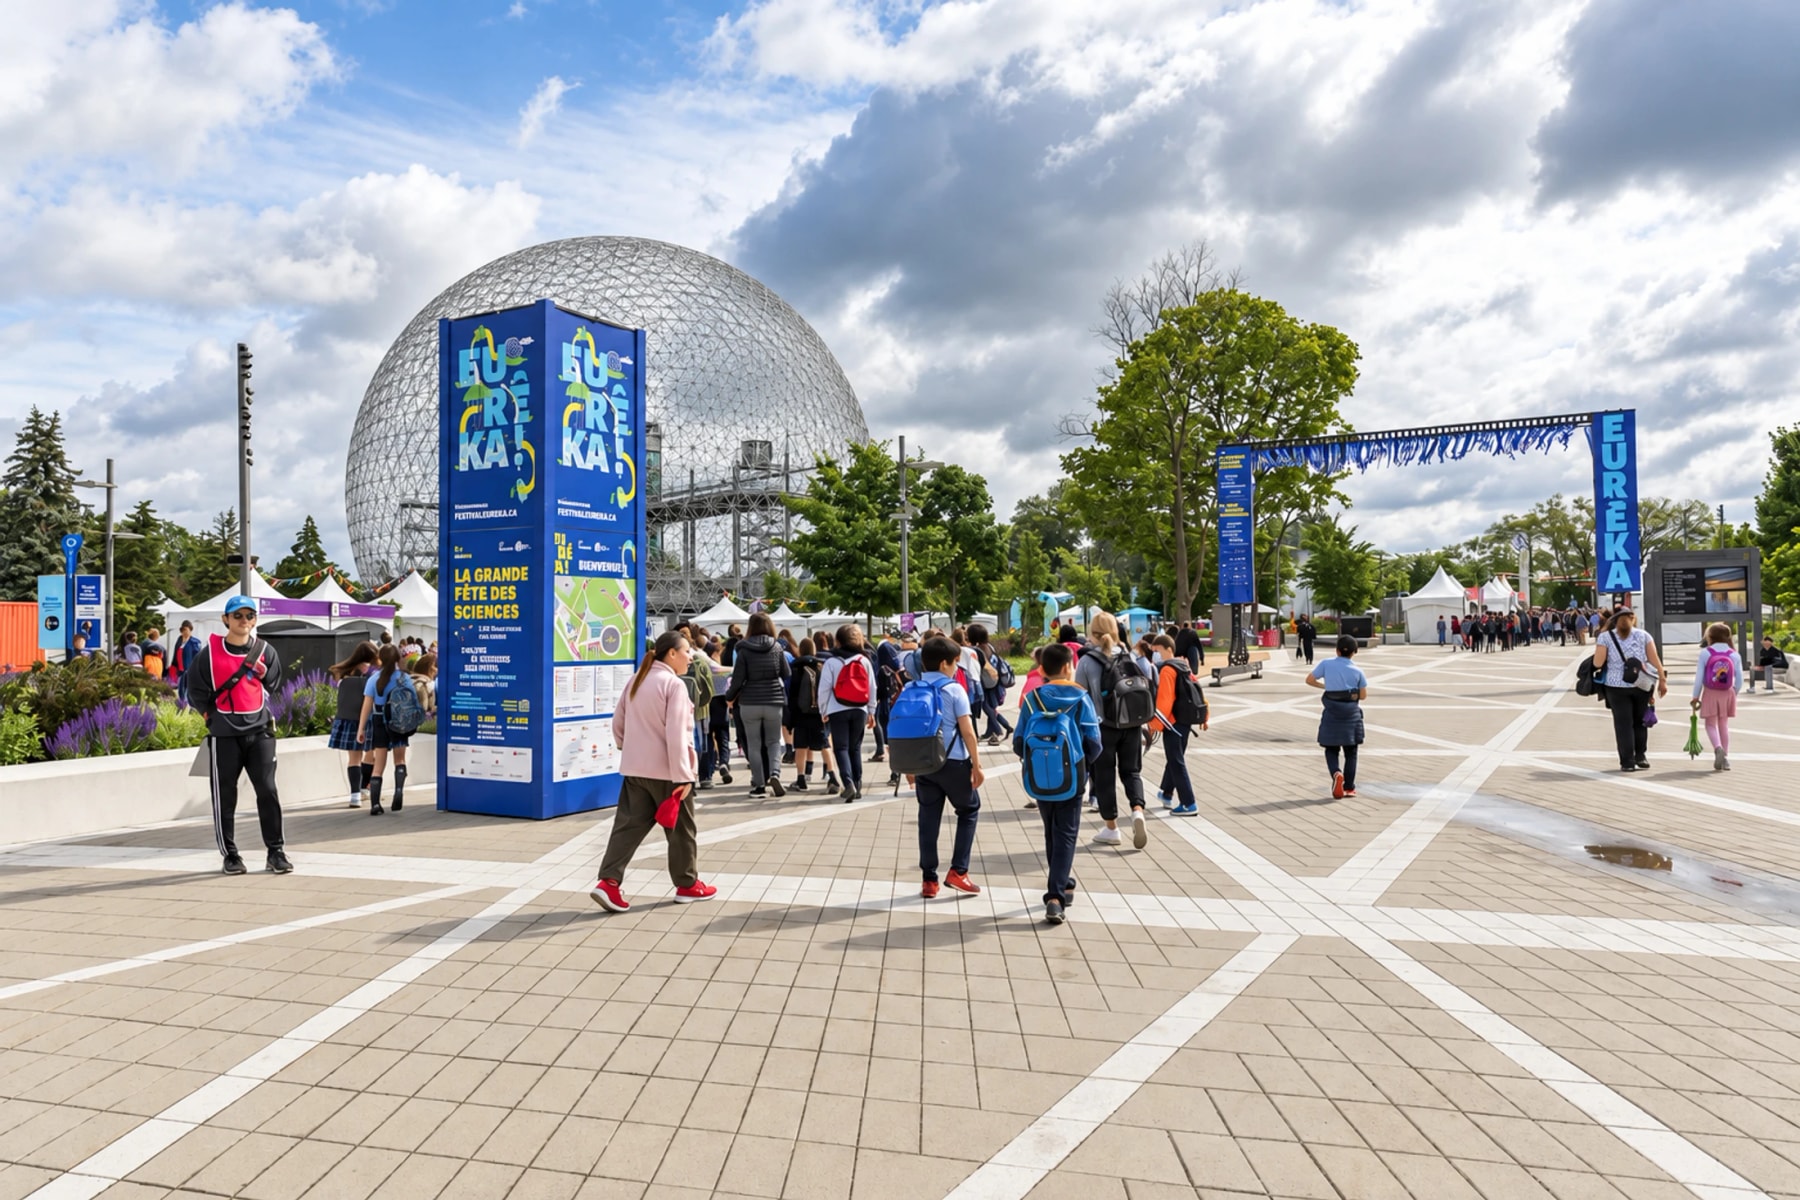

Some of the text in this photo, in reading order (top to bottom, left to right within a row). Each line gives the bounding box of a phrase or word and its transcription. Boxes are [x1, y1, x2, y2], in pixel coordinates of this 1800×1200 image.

[454, 566, 529, 583] LA GRANDE
[454, 582, 517, 601] FÊTE DES
[454, 604, 520, 620] SCIENCES
